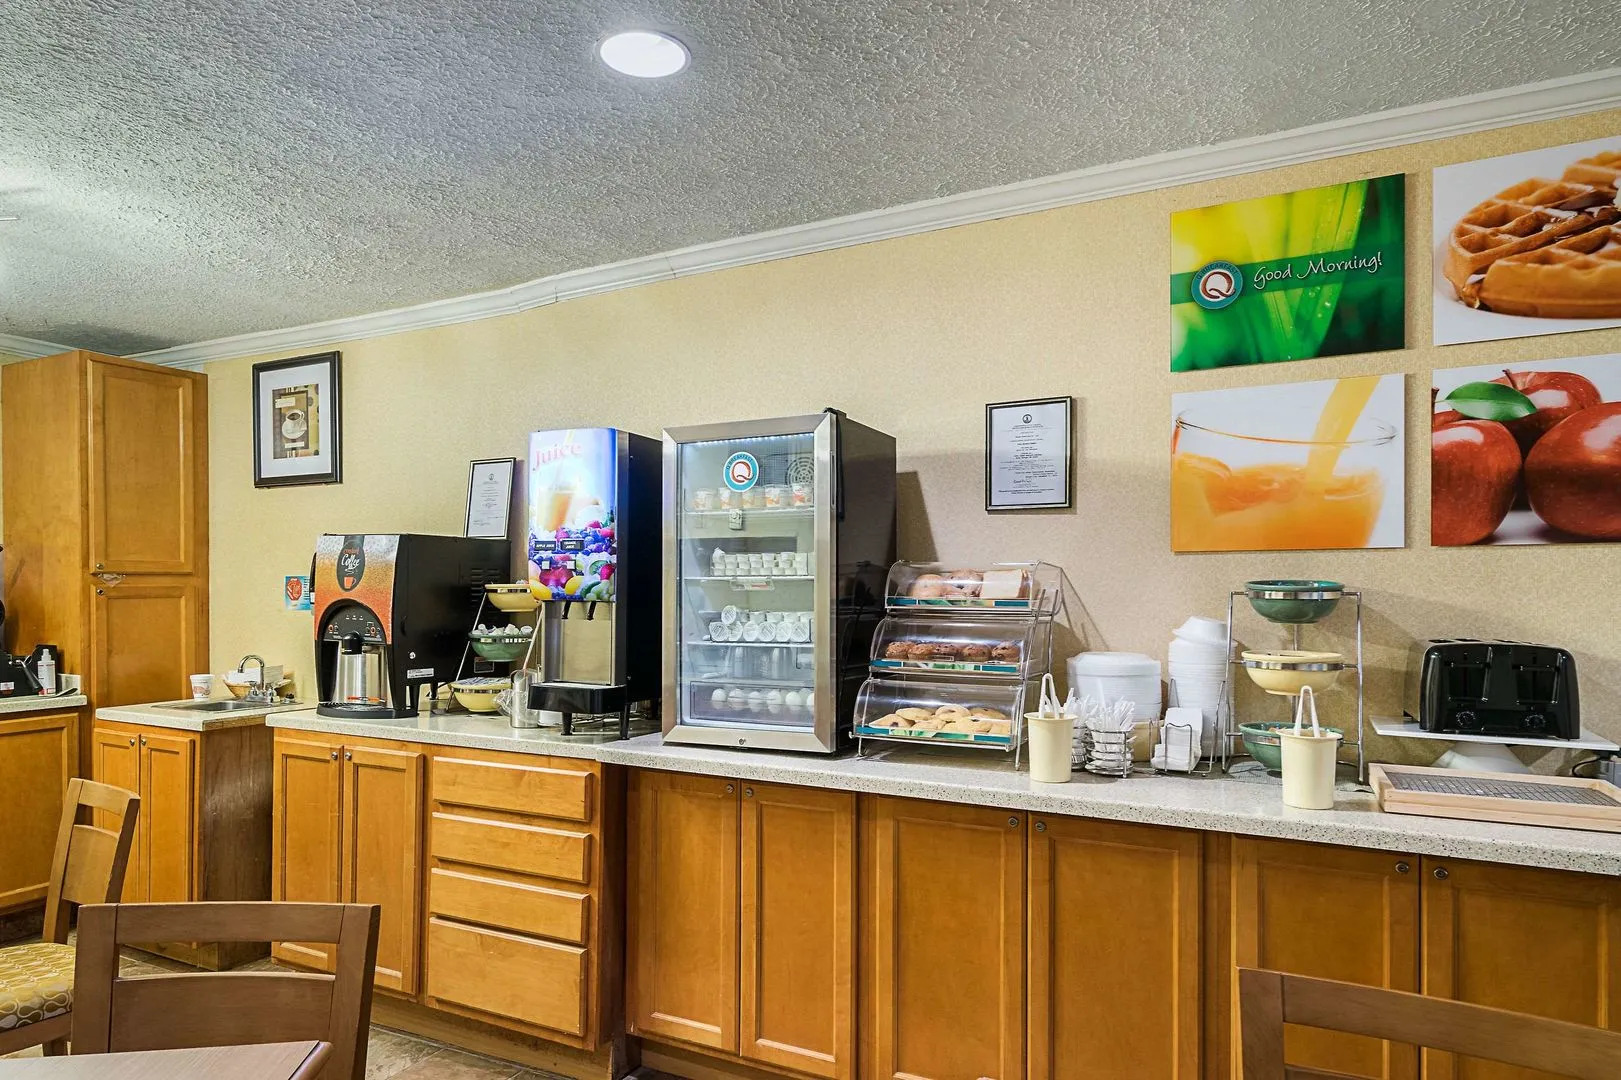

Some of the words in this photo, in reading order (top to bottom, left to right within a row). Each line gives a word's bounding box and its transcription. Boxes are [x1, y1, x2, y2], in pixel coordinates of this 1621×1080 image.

[1253, 263, 1292, 290] Good
[1297, 251, 1383, 279] Morning!
[532, 443, 582, 472] Juice
[341, 553, 361, 569] Coffee
